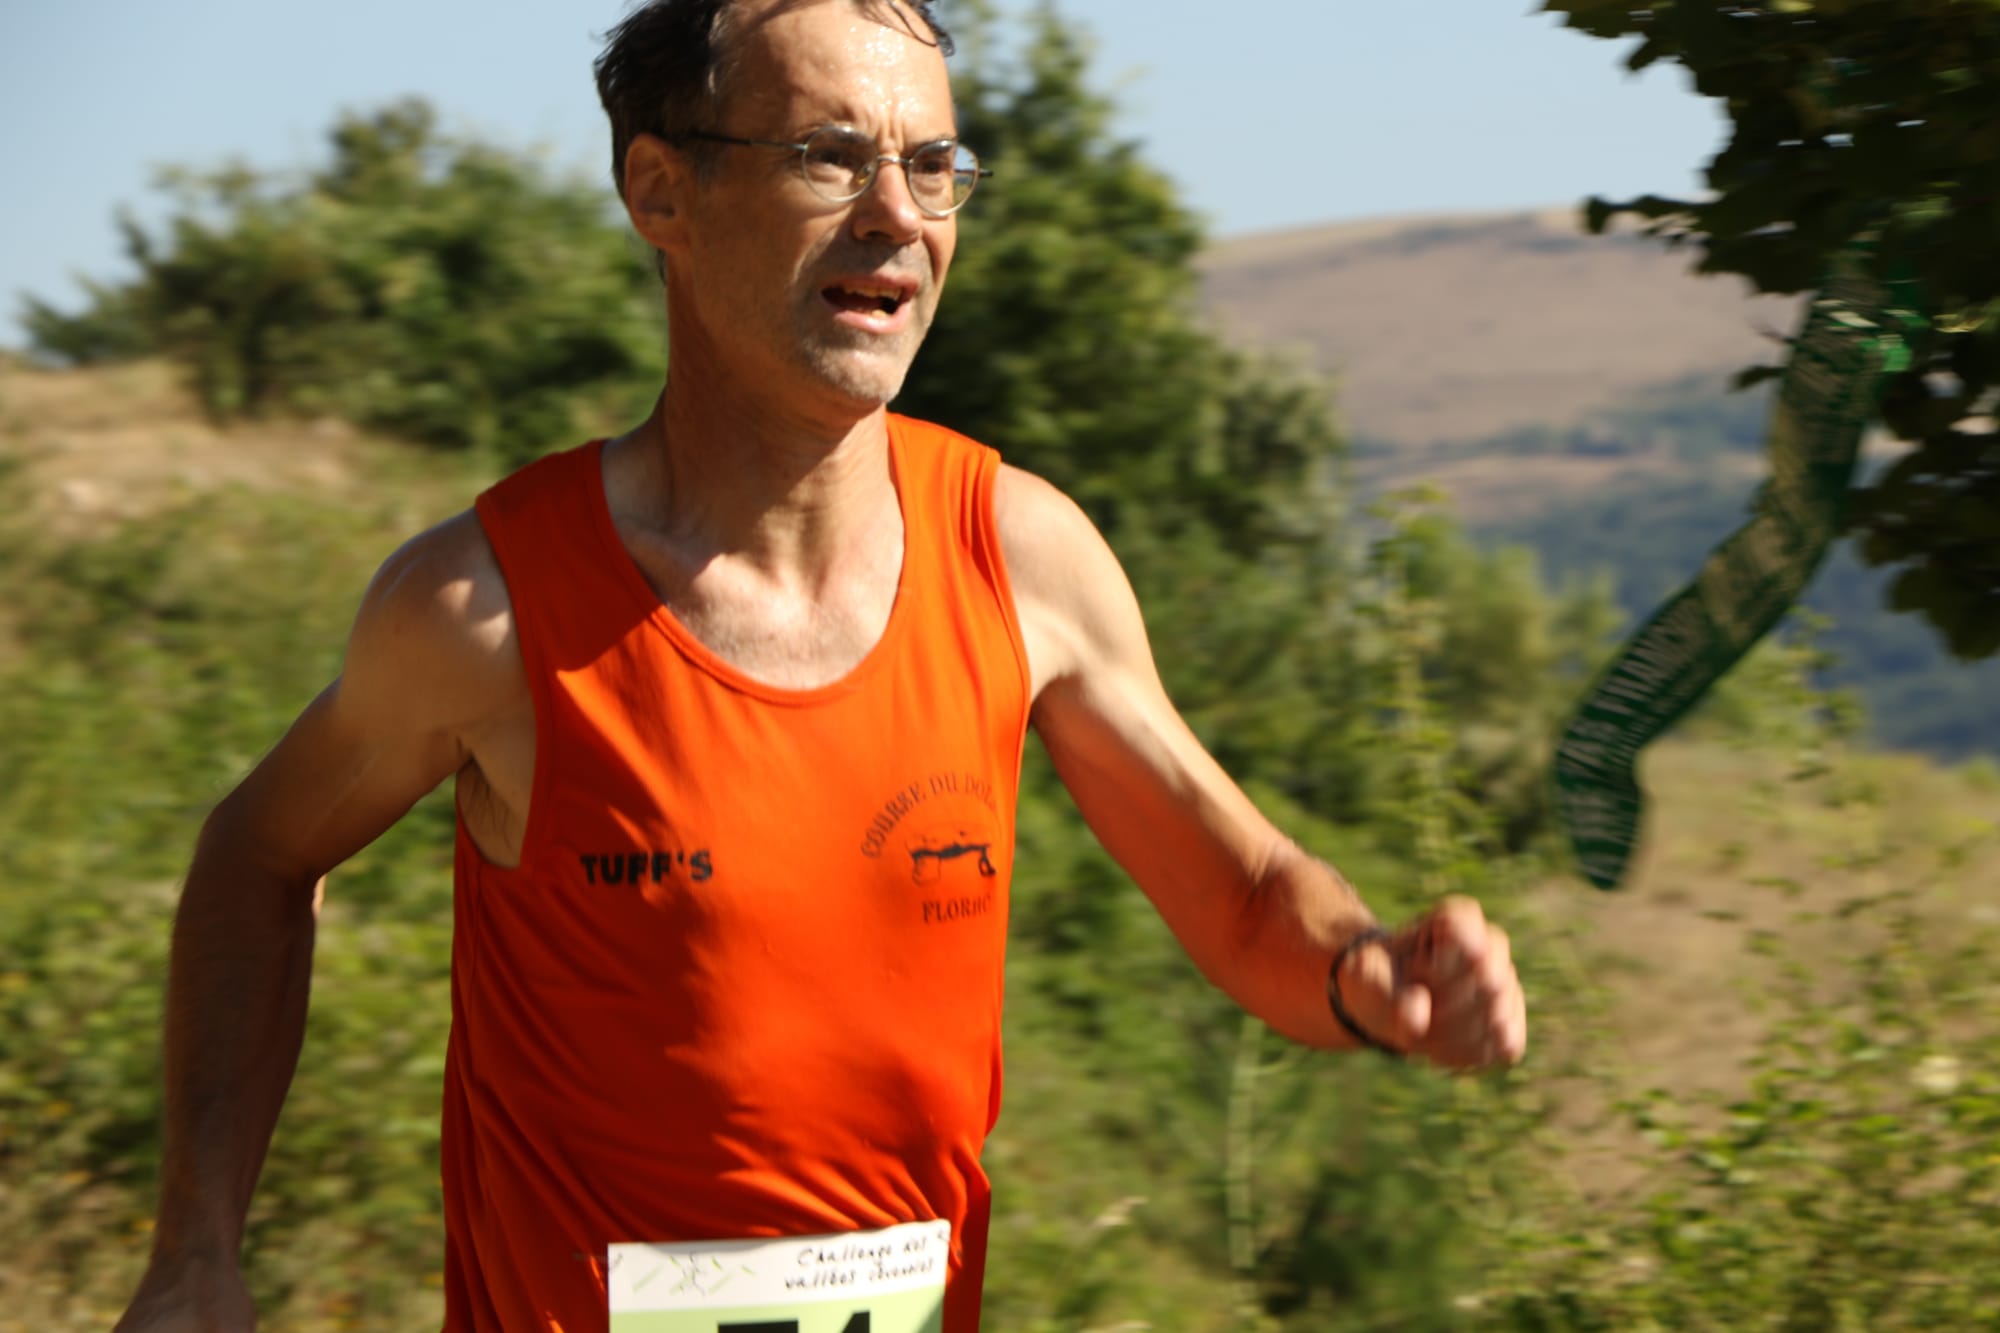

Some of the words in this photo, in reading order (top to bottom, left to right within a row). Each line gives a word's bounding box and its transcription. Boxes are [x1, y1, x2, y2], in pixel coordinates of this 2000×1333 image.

[860, 780, 926, 859] COURSE
[930, 773, 958, 796] DU
[580, 850, 713, 885] TUFF'S
